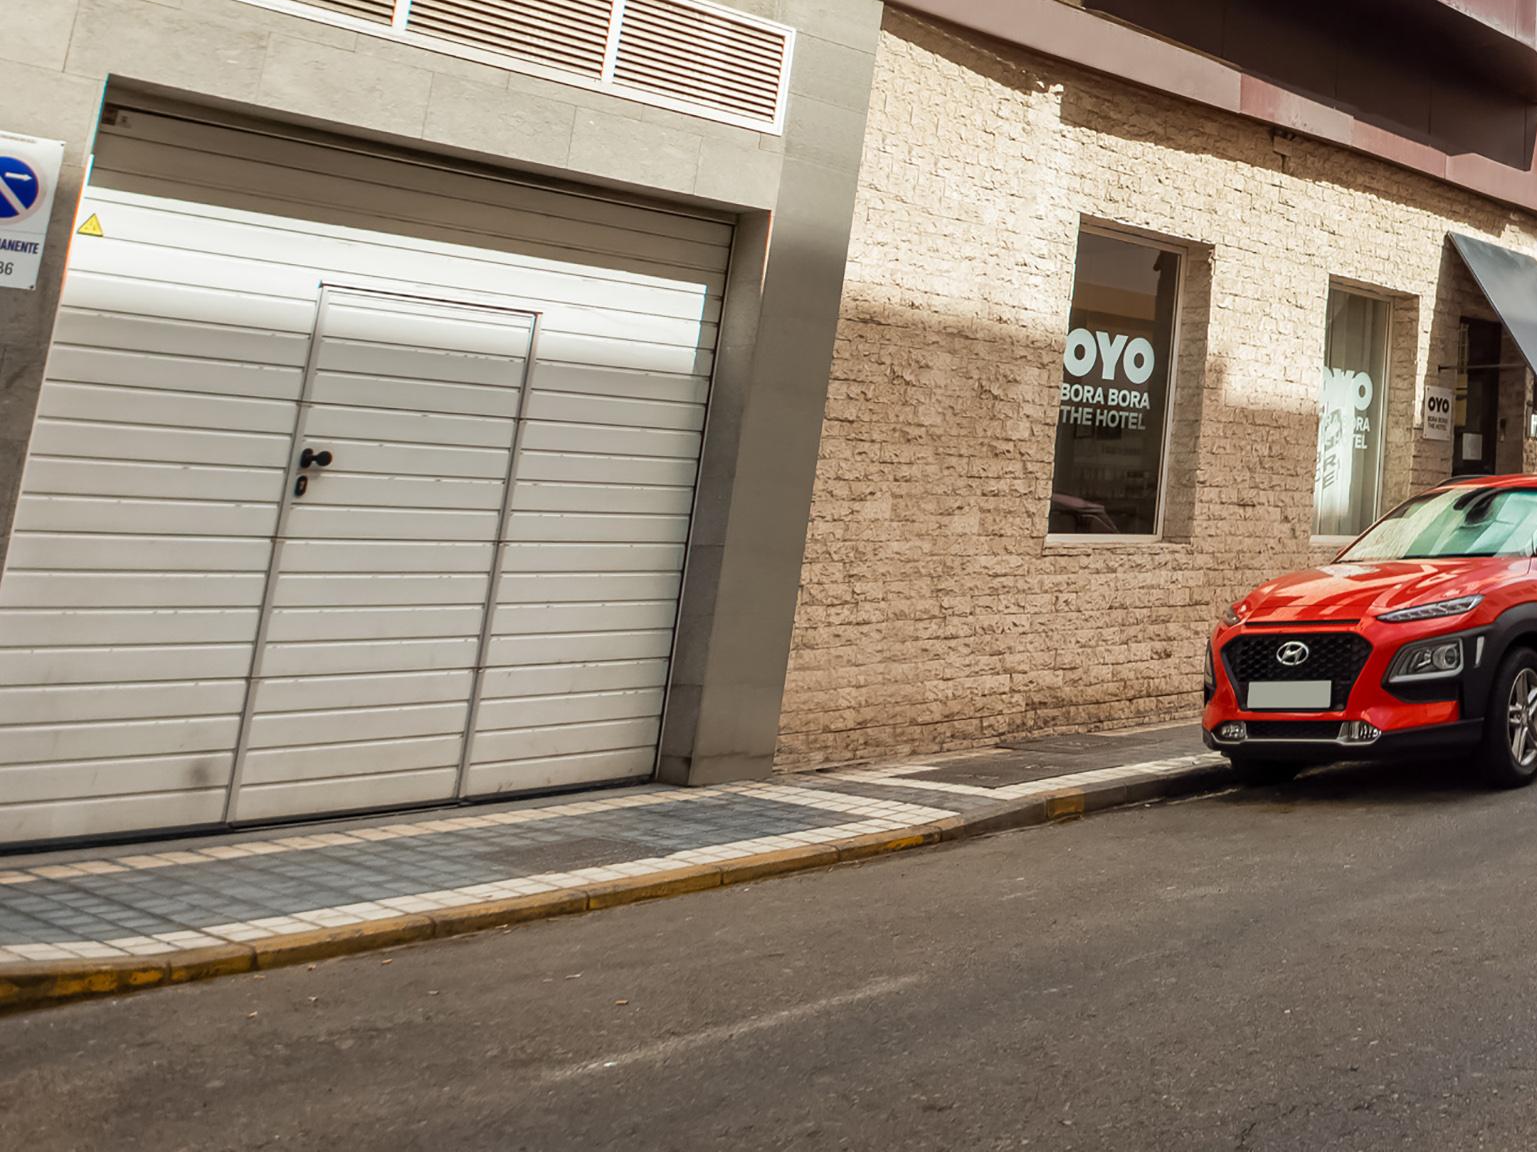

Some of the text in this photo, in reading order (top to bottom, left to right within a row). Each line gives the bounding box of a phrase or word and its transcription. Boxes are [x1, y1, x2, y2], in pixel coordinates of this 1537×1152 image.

[0, 238, 39, 255] ANENTE
[1063, 327, 1155, 385] OYO
[1060, 382, 1151, 410] BORA BORA
[1427, 396, 1450, 414] OYO
[1060, 405, 1146, 430] THE HOTEL
